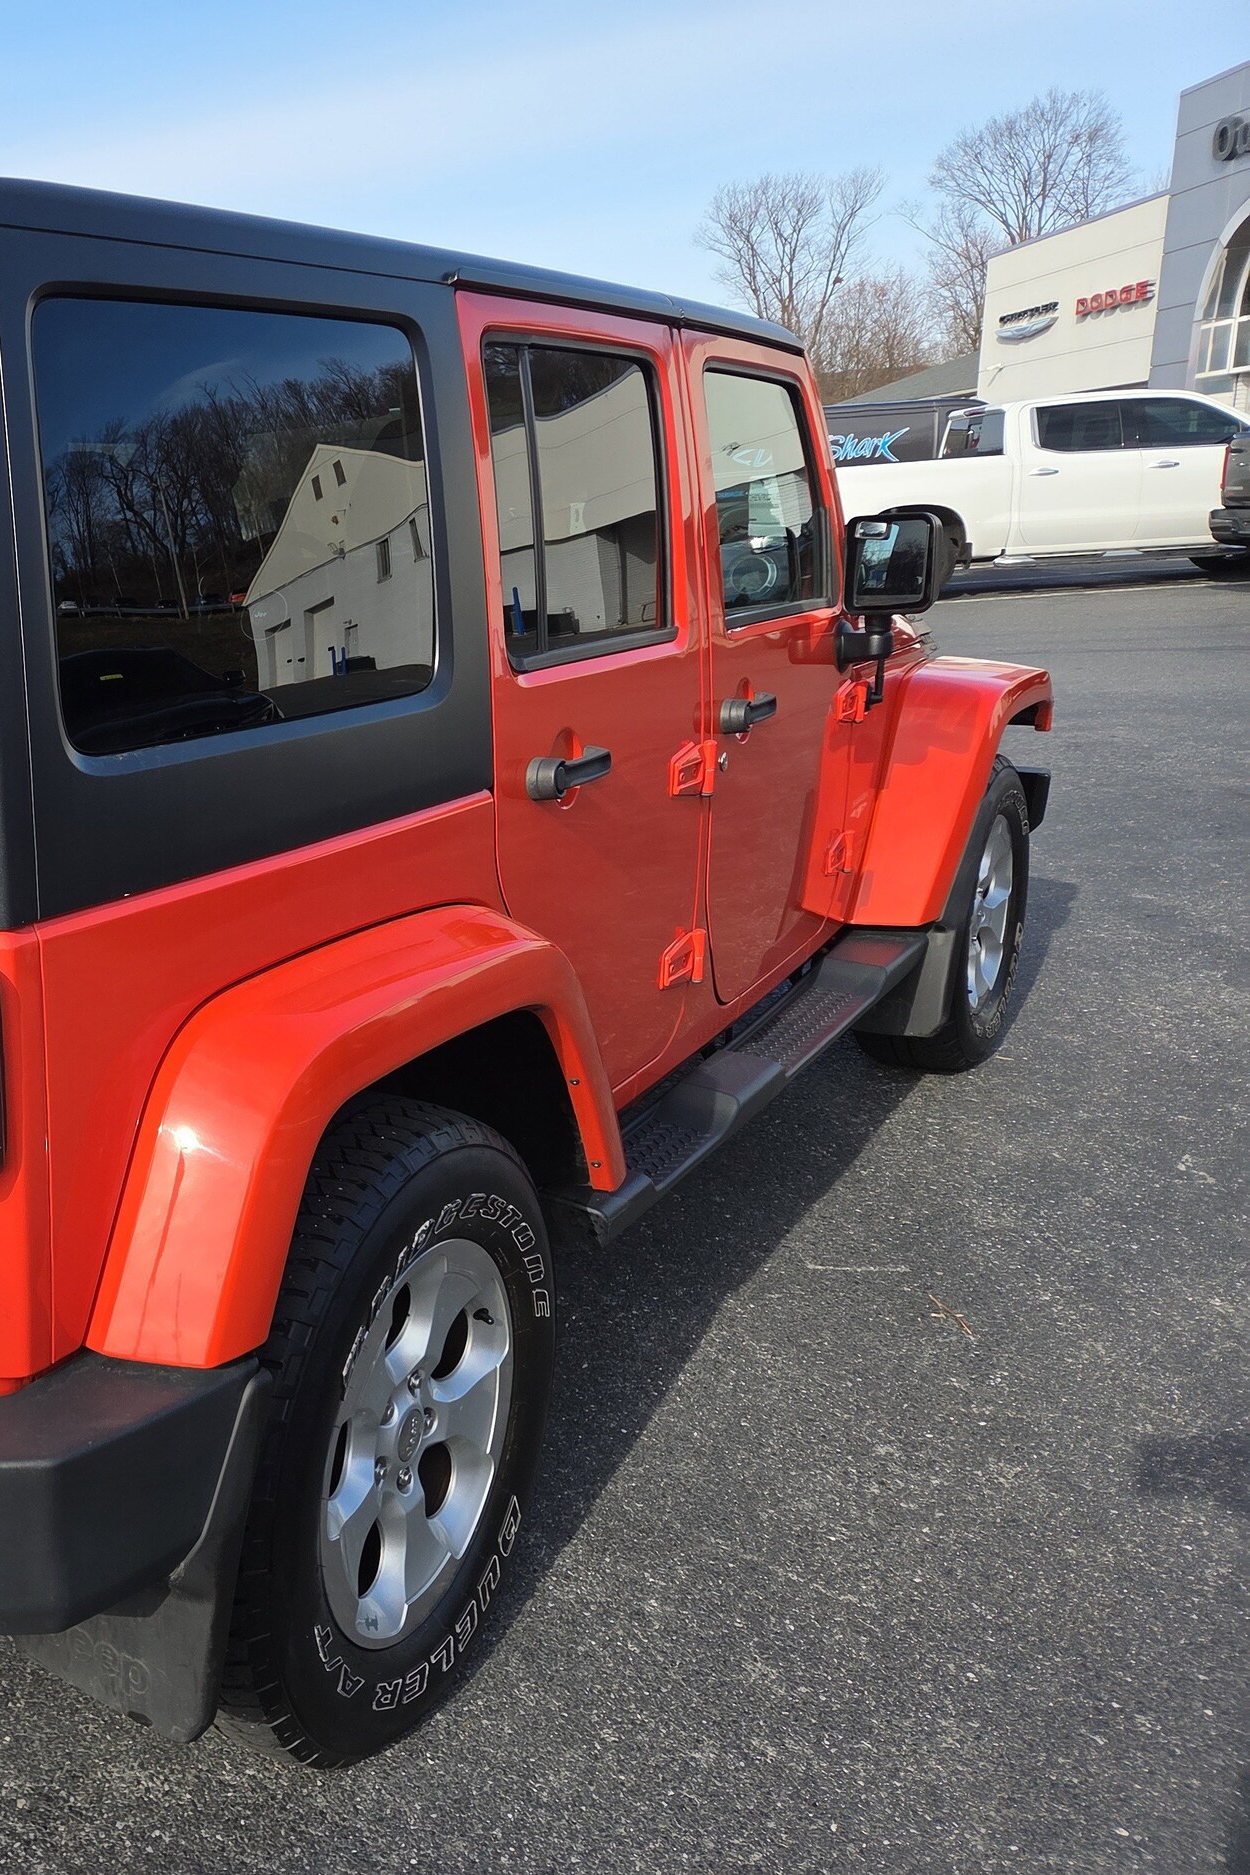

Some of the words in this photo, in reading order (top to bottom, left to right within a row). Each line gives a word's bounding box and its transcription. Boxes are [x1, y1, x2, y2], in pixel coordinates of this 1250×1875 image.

[1075, 280, 1155, 316] DODGE
[371, 1494, 522, 1712] DUELER
[314, 1624, 365, 1698] A/T
